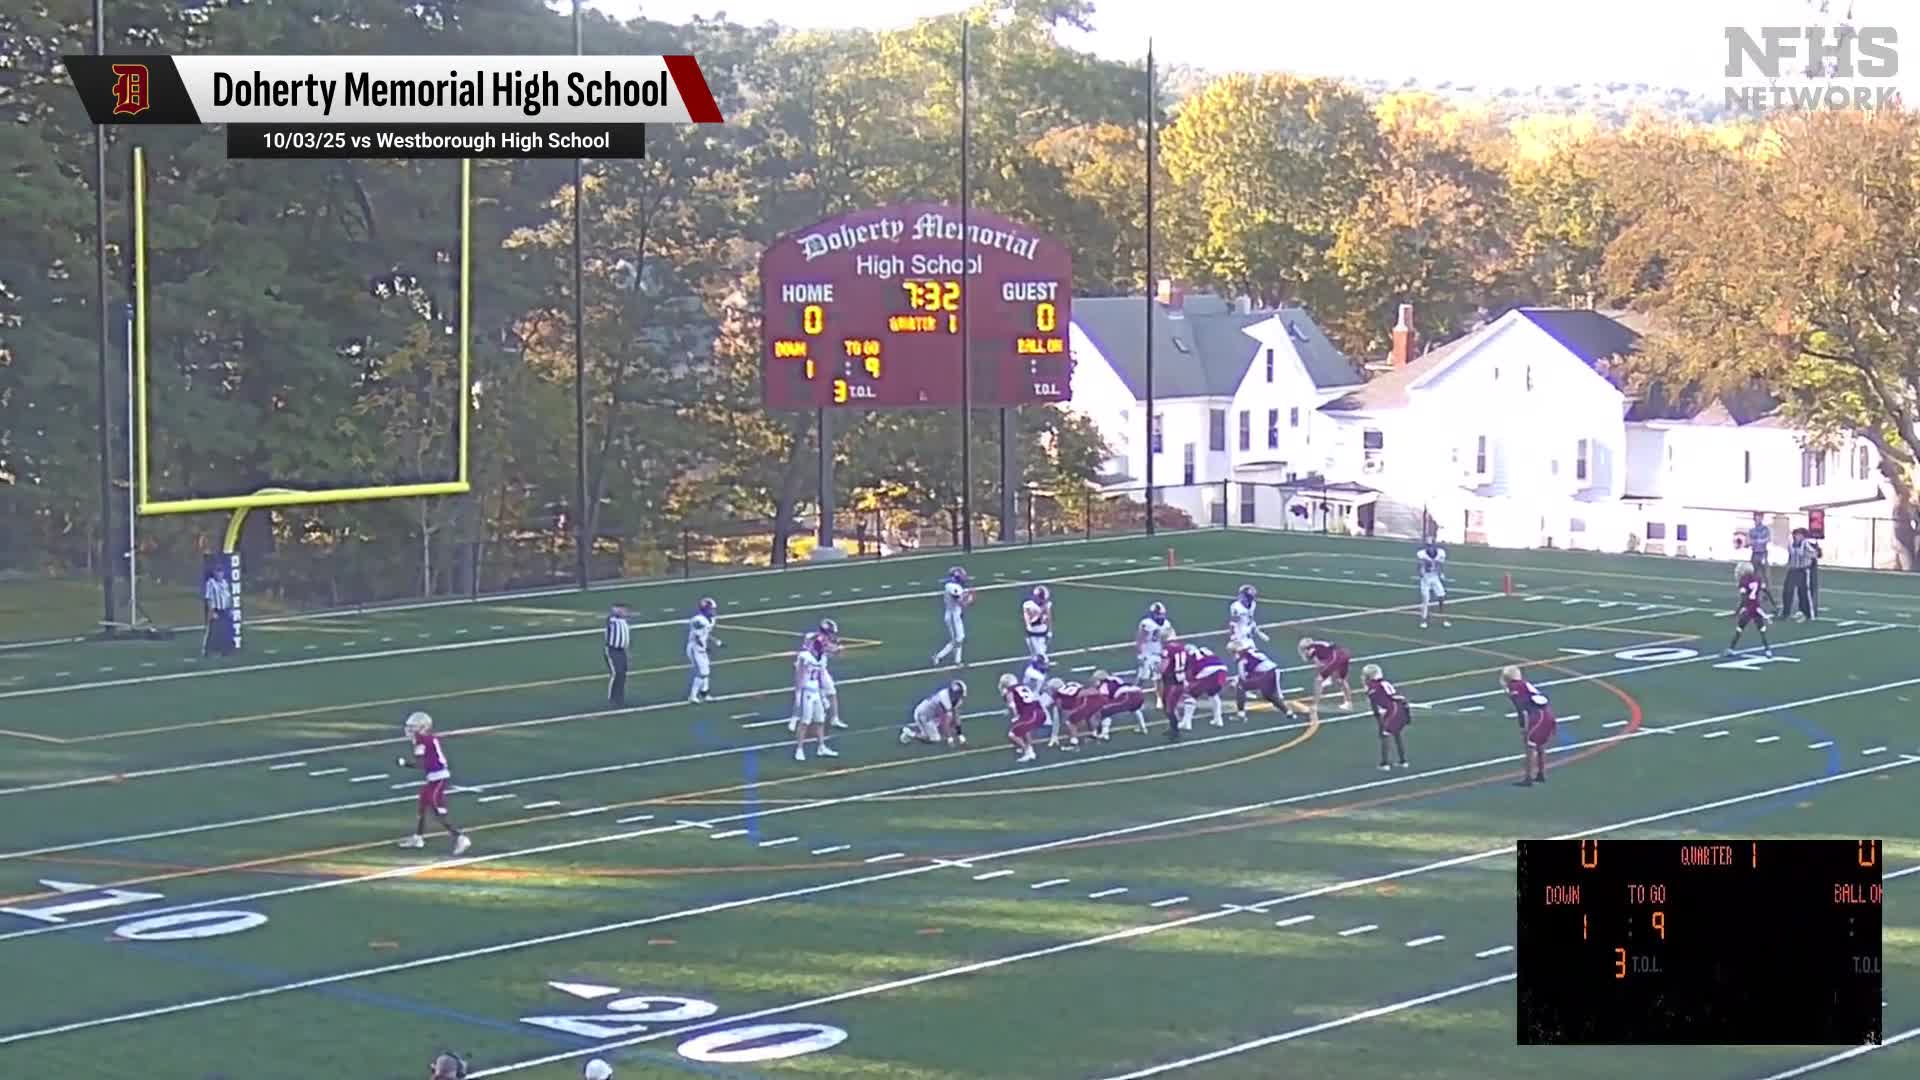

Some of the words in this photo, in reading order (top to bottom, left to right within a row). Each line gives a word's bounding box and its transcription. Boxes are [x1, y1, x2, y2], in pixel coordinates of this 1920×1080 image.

[797, 217, 905, 262] Doherty
[912, 212, 1040, 260] Memorial
[856, 253, 905, 279] High
[911, 253, 982, 275] School
[781, 284, 834, 303] HOME
[902, 281, 961, 311] 7:32
[1002, 281, 1059, 301] GUEST
[803, 304, 824, 335] 0
[1036, 302, 1056, 332] 0
[864, 356, 880, 378] 9
[834, 380, 847, 403] 3
